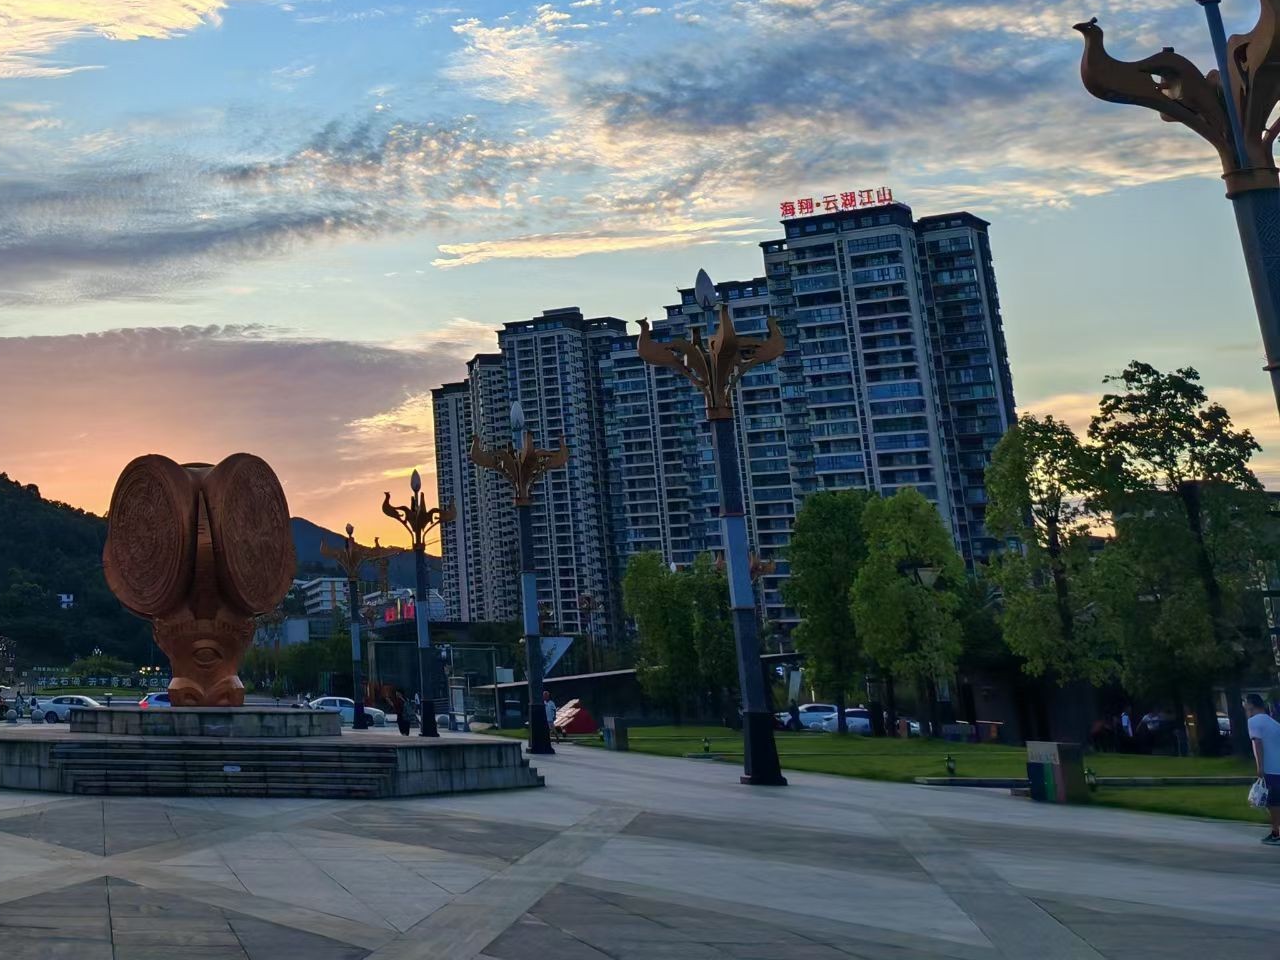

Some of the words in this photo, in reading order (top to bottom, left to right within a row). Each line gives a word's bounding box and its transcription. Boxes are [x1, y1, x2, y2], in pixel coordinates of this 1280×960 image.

[780, 186, 893, 217] 海翔·云湖江山
